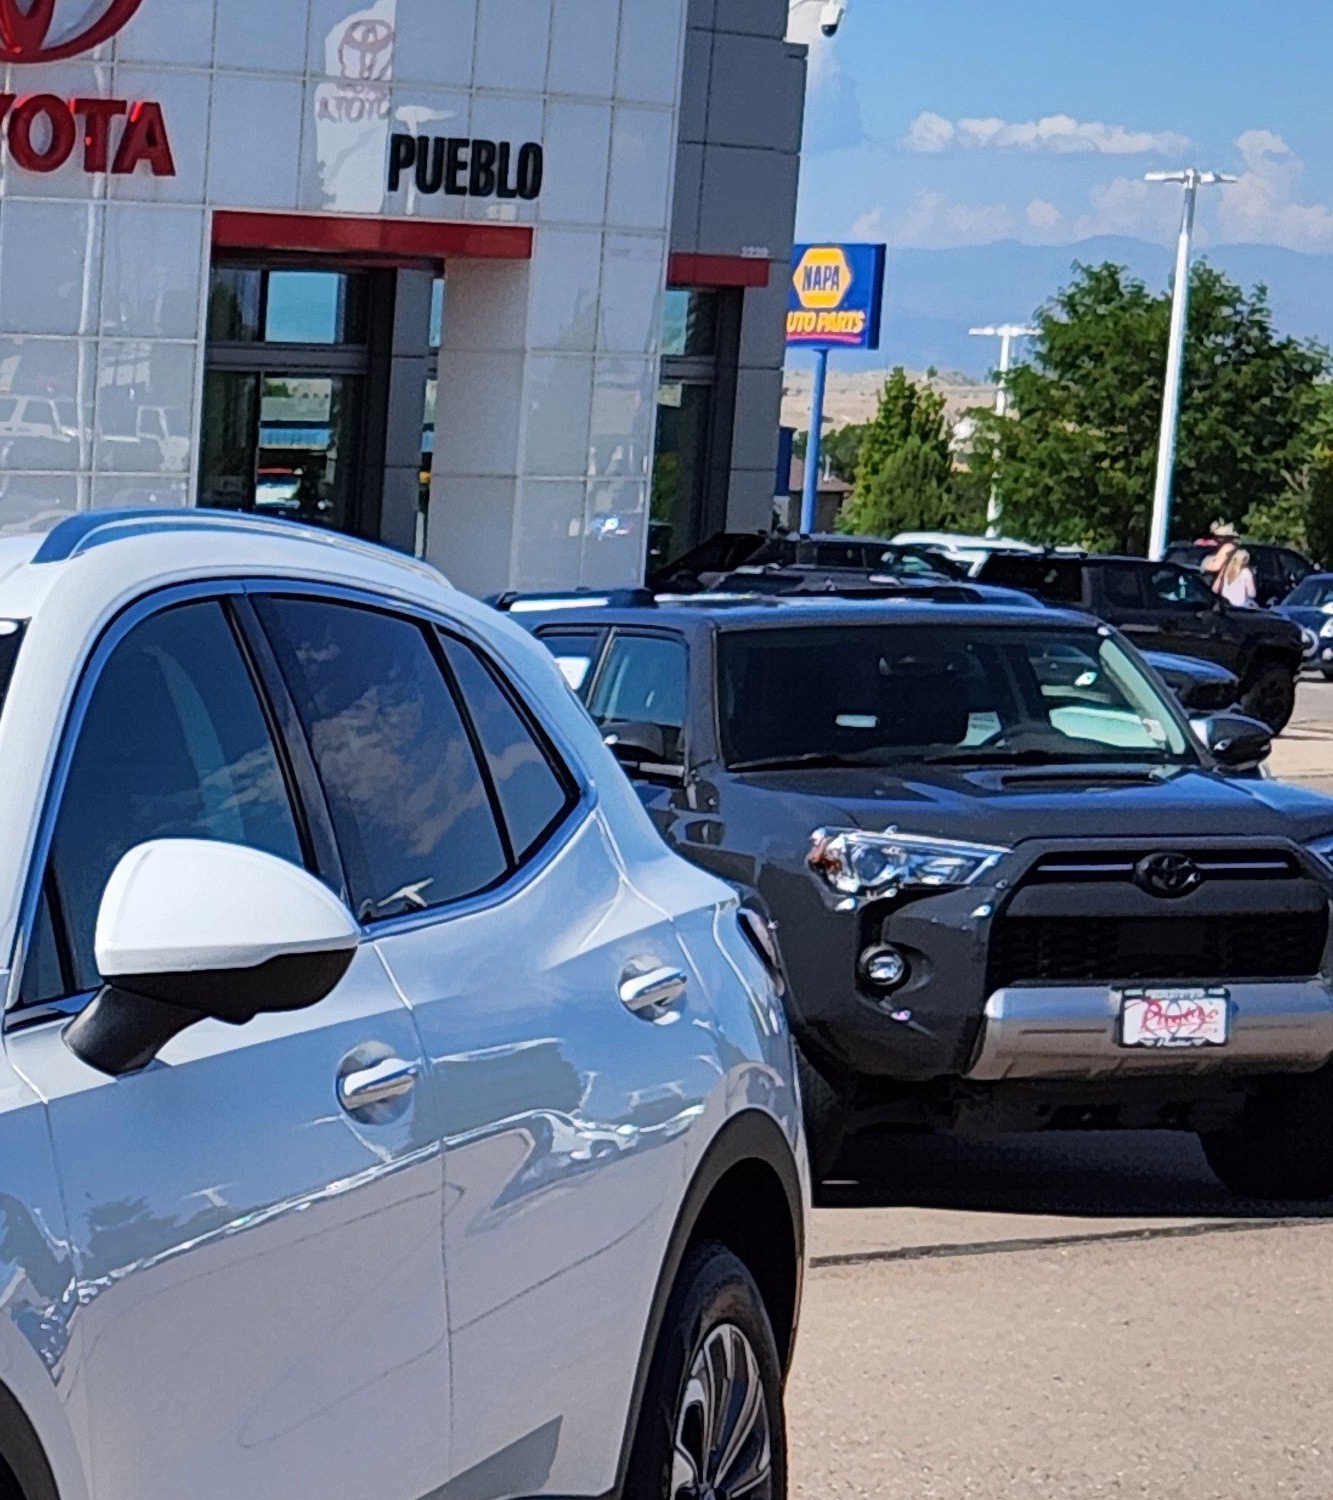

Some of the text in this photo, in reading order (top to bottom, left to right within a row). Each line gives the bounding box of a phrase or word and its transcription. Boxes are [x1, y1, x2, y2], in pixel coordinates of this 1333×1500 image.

[388, 132, 543, 200] PUEBLO
[801, 264, 841, 291] NAPA
[786, 310, 865, 334] UTO PARTS
